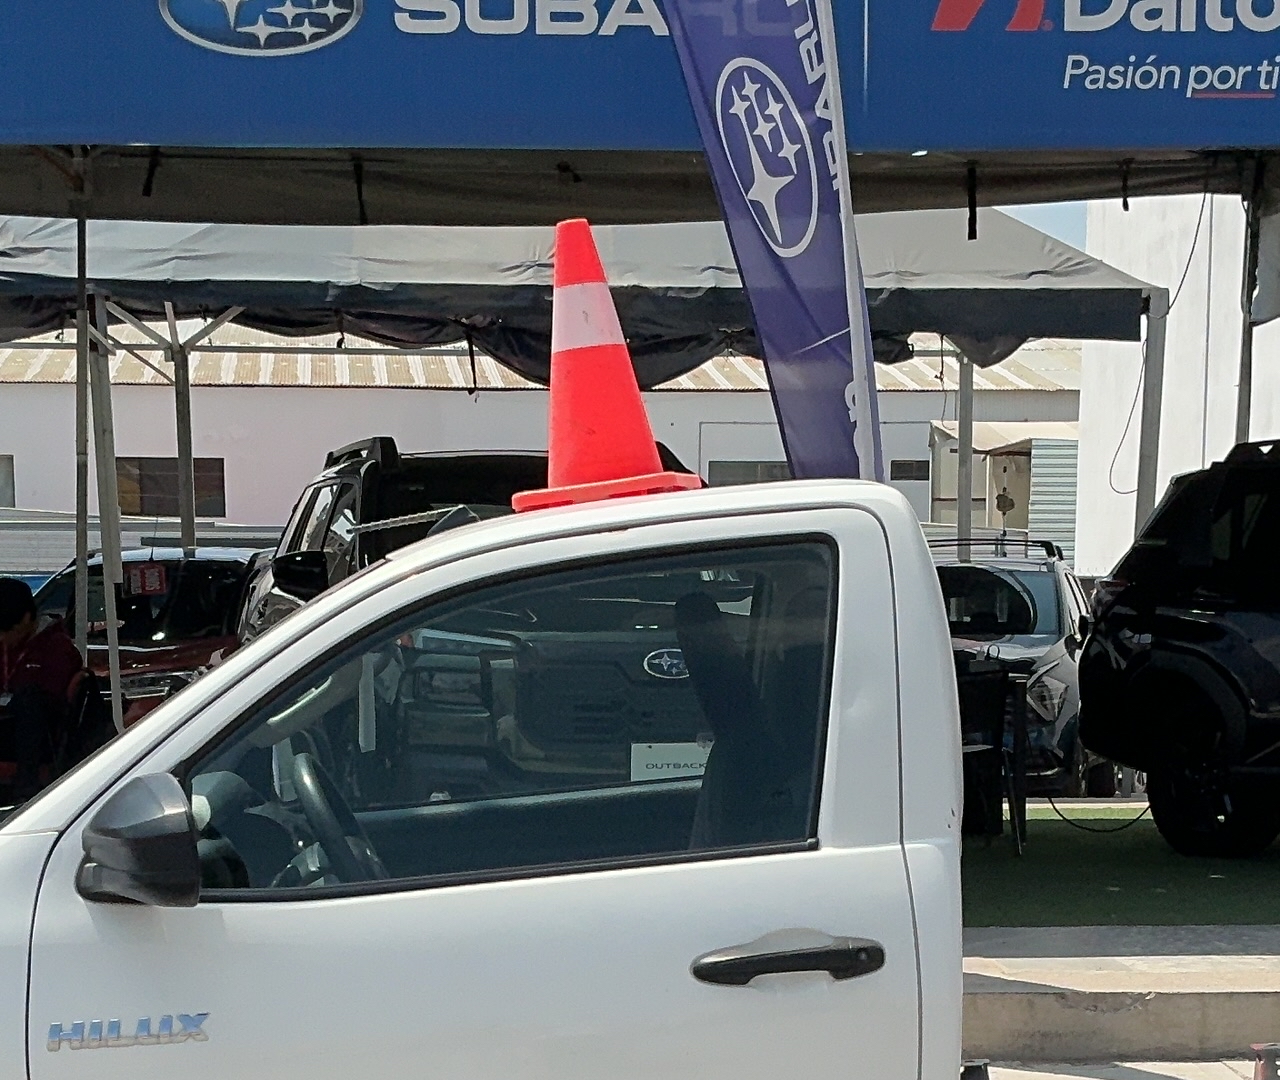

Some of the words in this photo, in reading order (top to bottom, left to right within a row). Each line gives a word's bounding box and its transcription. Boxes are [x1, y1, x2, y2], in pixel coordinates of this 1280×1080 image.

[1063, 54, 1180, 89] Pasión
[1186, 65, 1252, 98] por
[645, 762, 707, 770] OUTBACK
[46, 1011, 211, 1051] HILUX
